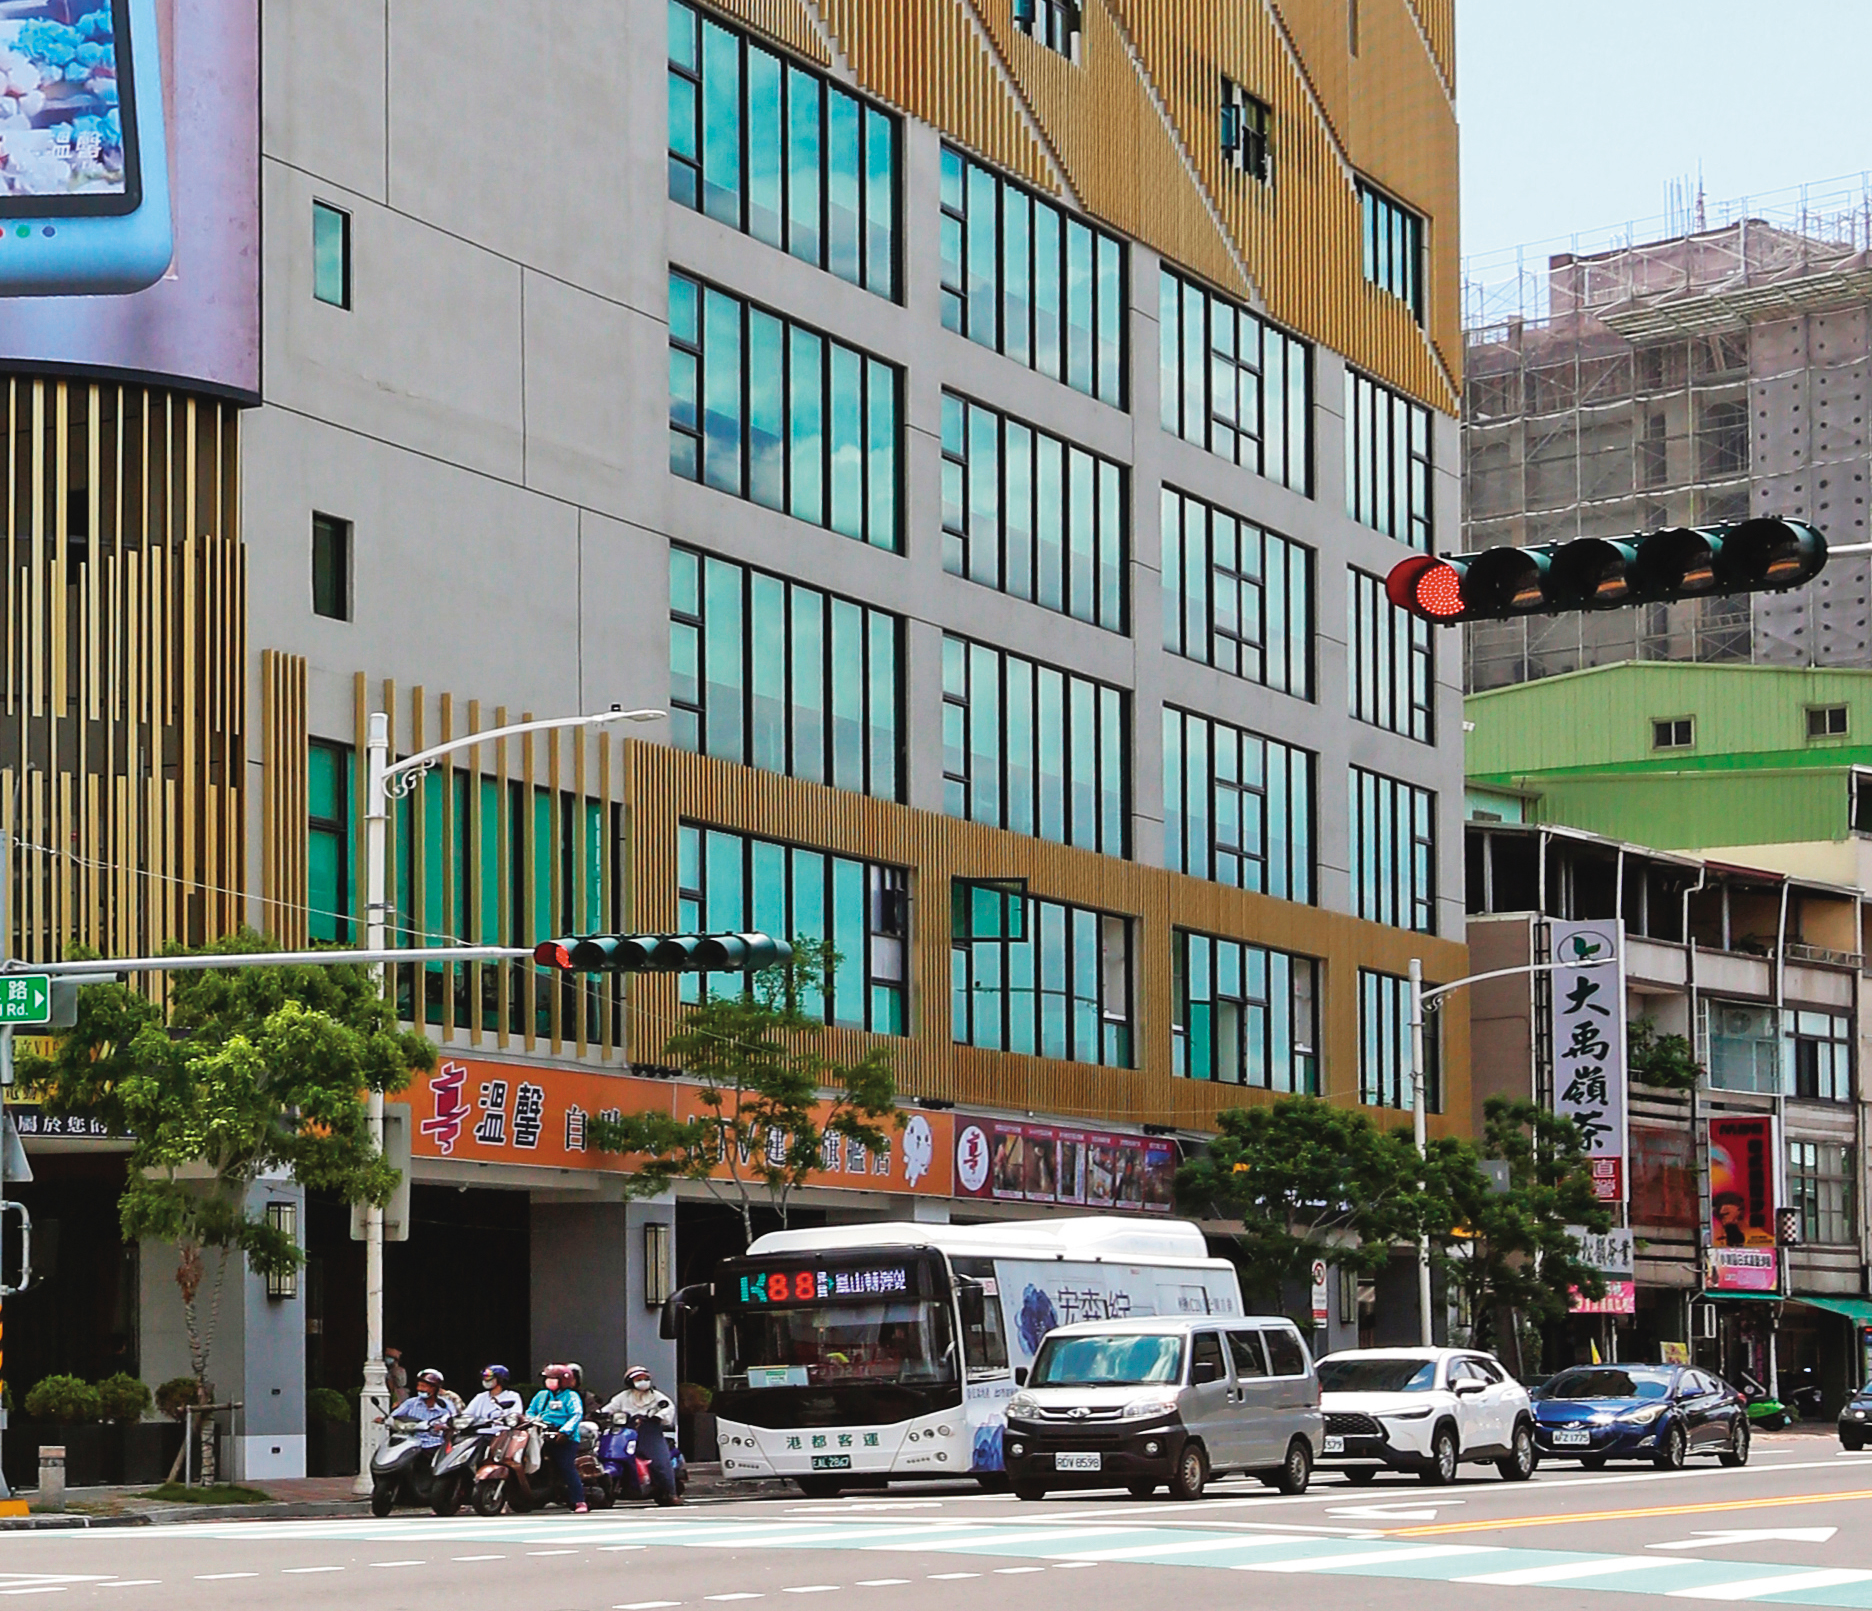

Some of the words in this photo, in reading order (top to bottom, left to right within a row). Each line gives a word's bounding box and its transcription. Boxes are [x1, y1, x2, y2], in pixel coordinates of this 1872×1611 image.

[6, 1003, 29, 1017] Rd.
[1561, 975, 1614, 1152] 大禹嶺茶
[739, 1270, 816, 1303] K88
[786, 1432, 880, 1450] 港都客運
